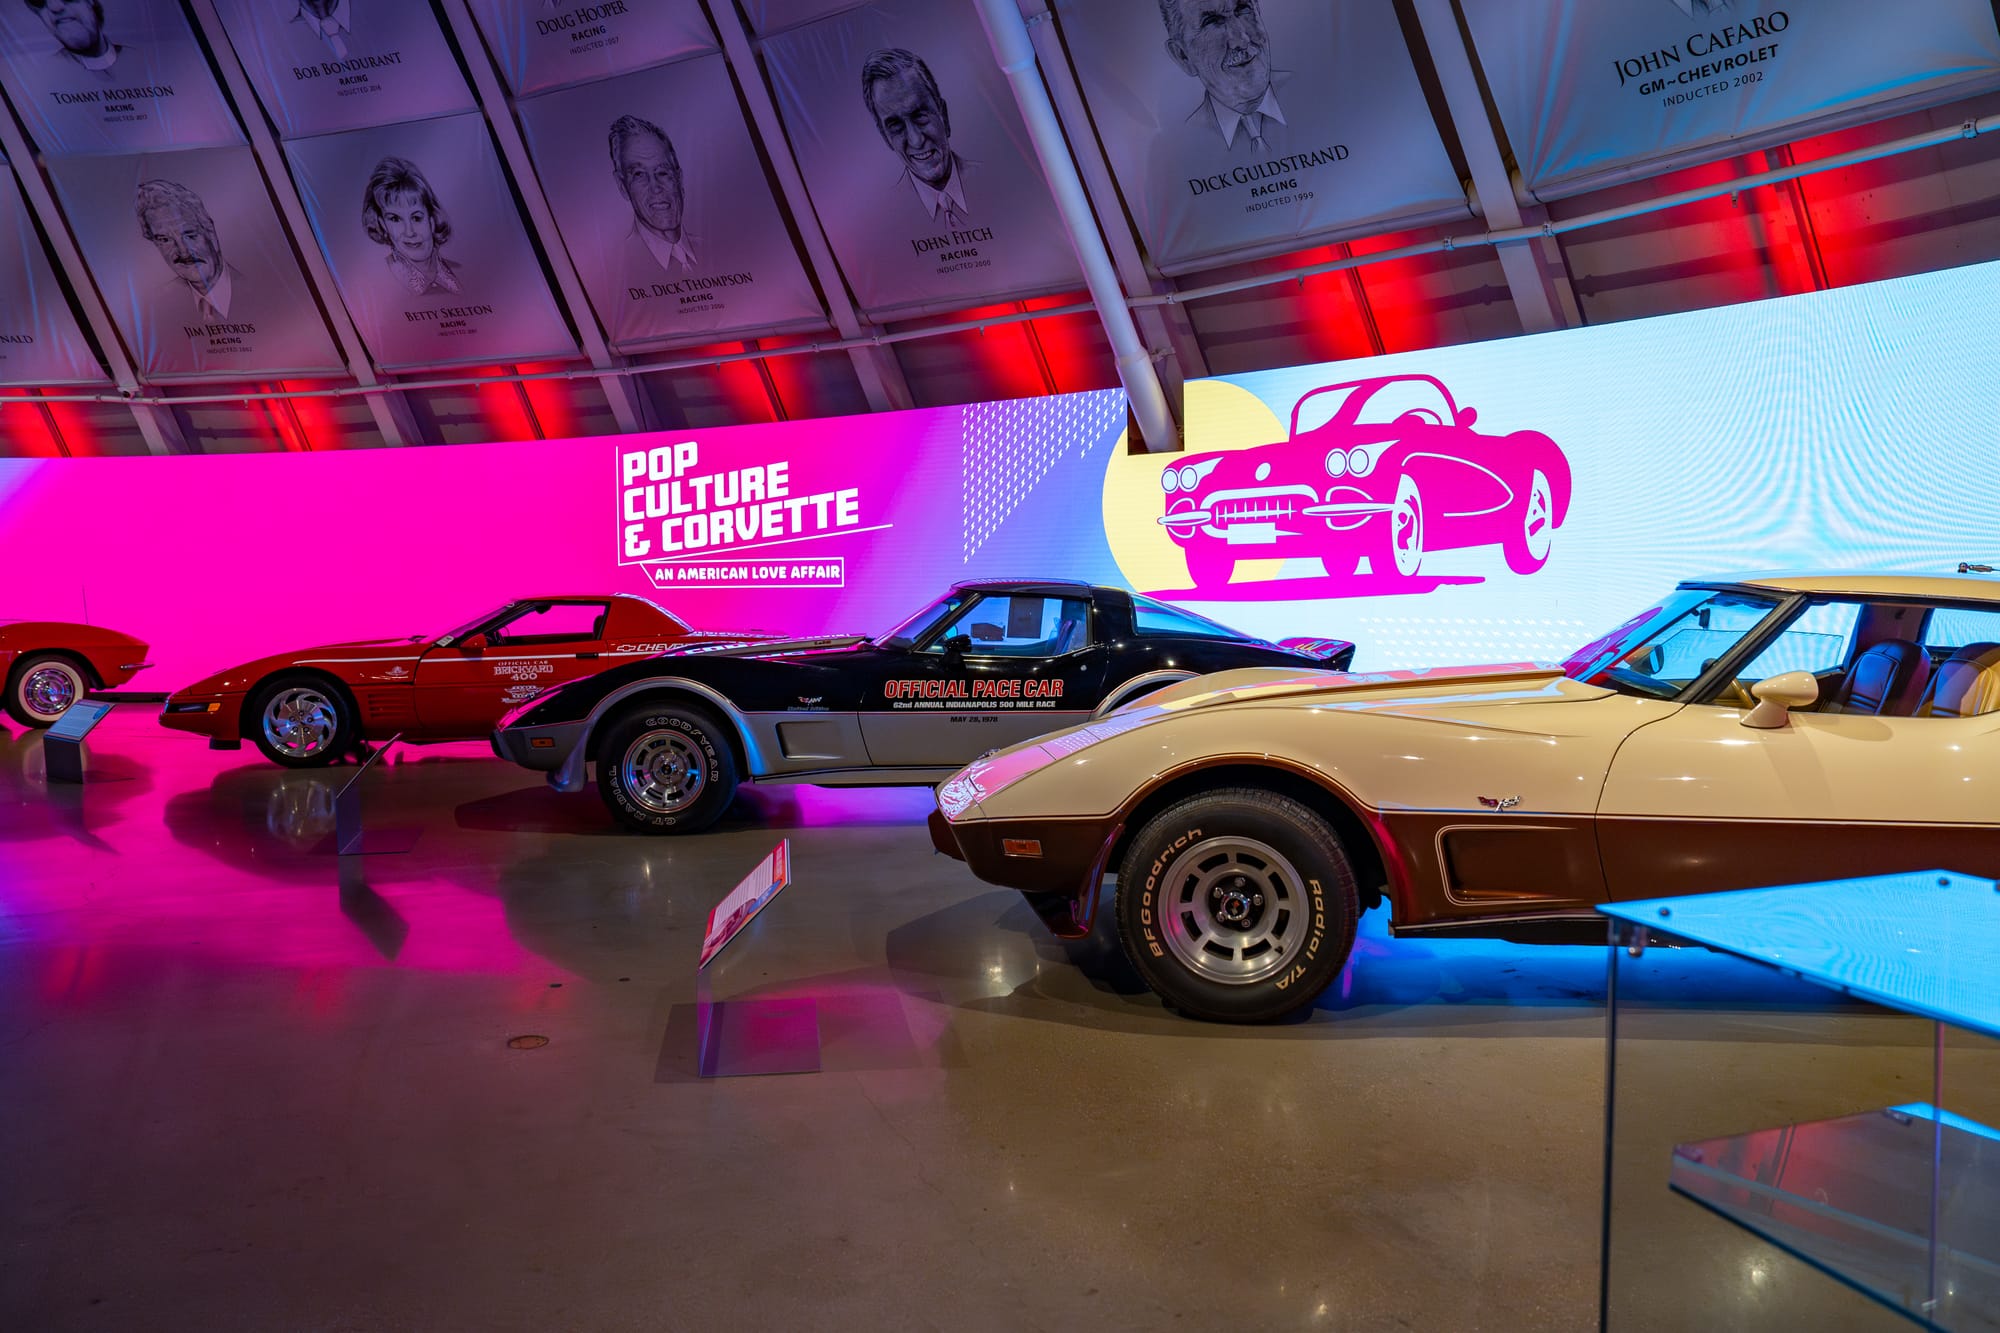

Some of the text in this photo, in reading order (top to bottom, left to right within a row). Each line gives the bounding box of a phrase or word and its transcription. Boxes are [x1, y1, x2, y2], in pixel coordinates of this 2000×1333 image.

[536, 0, 628, 35] DOUG HOOPER
[571, 25, 606, 42] RACING
[569, 40, 604, 56] INDUCTED
[1613, 11, 1789, 87] JOHN CAFARO
[293, 51, 402, 80] BOB BONDURANT
[339, 74, 368, 86] RACING
[1663, 71, 1763, 107] INDUCTED 2002
[50, 86, 174, 105] TOMMY MORRISON
[104, 104, 134, 112] RACING
[1188, 144, 1350, 196] DICK GULDSTRAND
[1251, 178, 1298, 198] RACING
[1246, 191, 1314, 213] INDUCTED 1999
[911, 227, 994, 257] JOHN FITCH
[940, 248, 978, 262] RACING
[936, 262, 973, 275] INDUCTED
[628, 272, 754, 301] DR. DICK THOMPSON
[680, 293, 714, 304] RACING
[404, 305, 493, 322] BETTY SKELTON
[184, 323, 256, 339] JIM JEFFORDS
[440, 320, 467, 328] RACING
[210, 337, 242, 345] RACING
[623, 441, 698, 486] POP
[624, 461, 789, 522] CULTURE
[624, 487, 859, 558] & CORVETTE
[655, 565, 840, 581] AN AMERICAN LOVE AFFAIR
[494, 665, 554, 675] BRICKYARD
[511, 673, 538, 681] 400
[884, 679, 1064, 698] OFFICIAL PACE CAR
[893, 701, 1056, 709] 62nd ANNUAL INDIANAPOLIS 500 MILE RACE
[645, 716, 719, 783] GOODYEAR
[609, 765, 676, 825] GT RADIAL
[1141, 828, 1202, 958] BFGoodrich
[1275, 879, 1326, 990] Radial T/A
